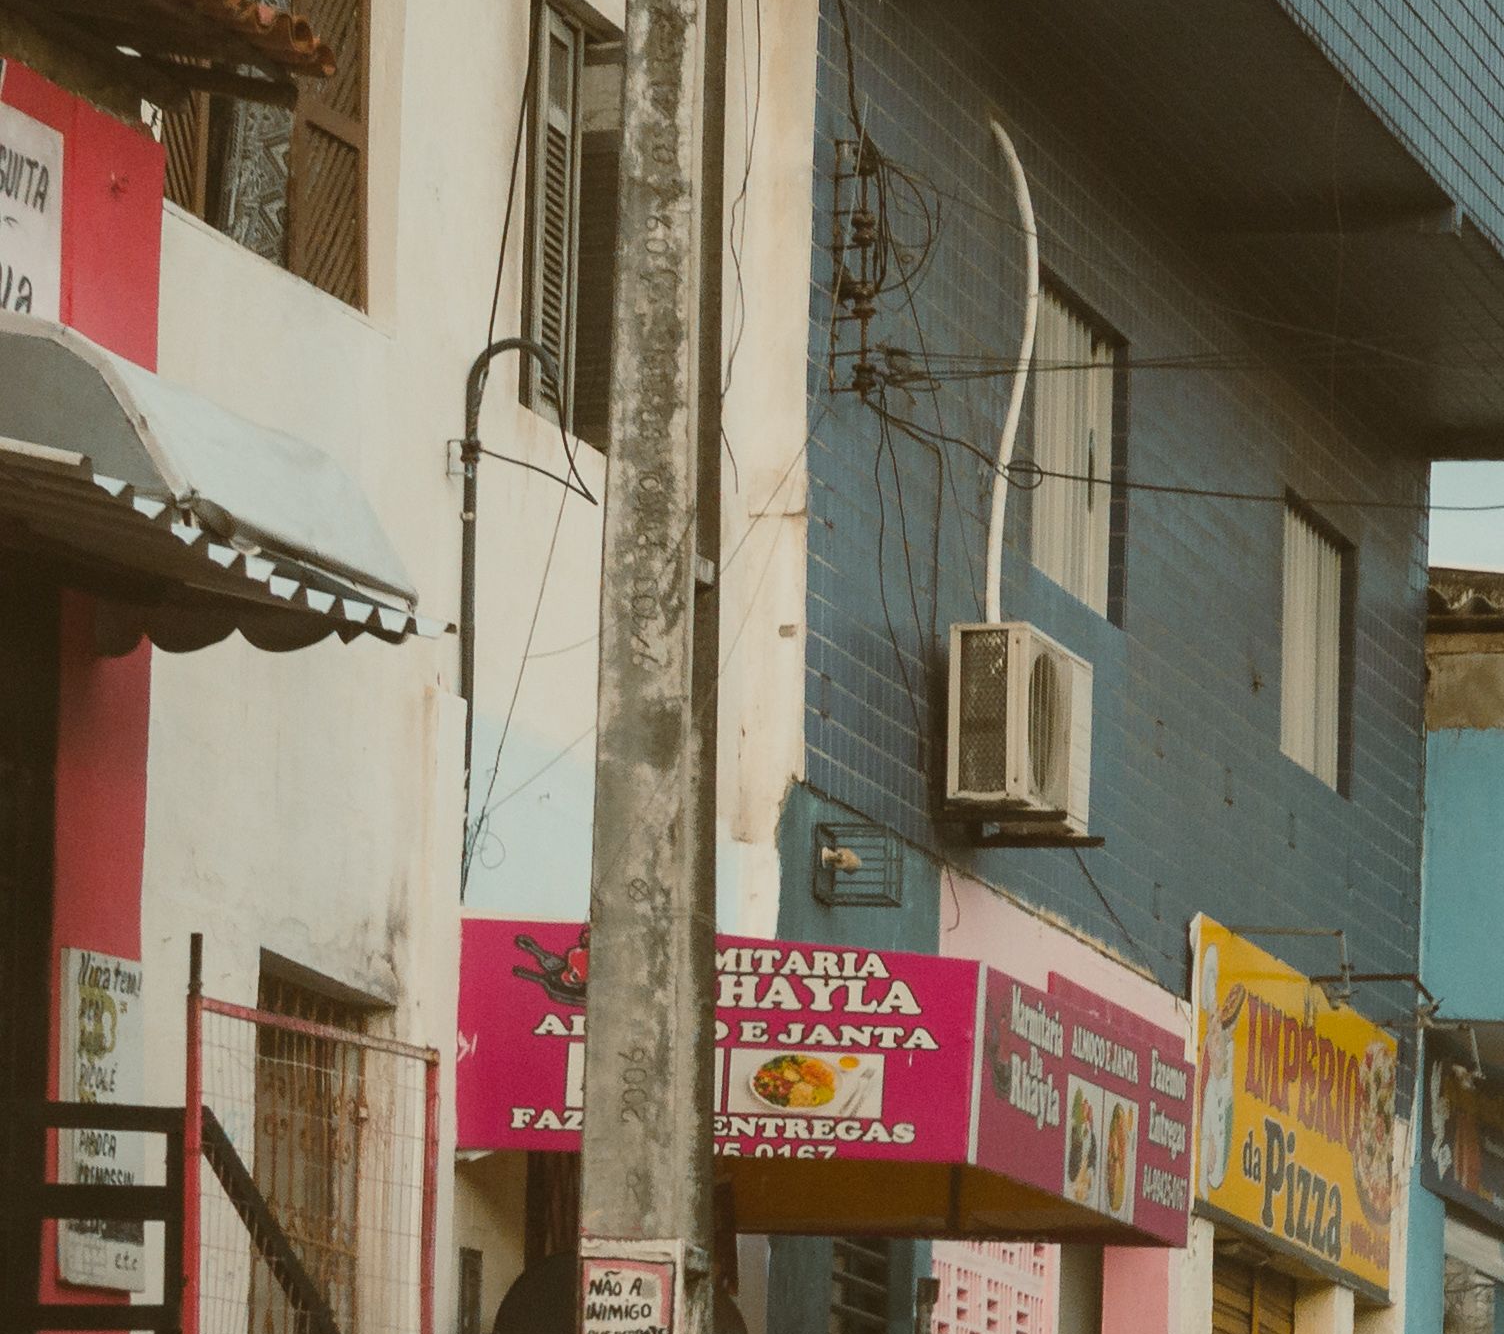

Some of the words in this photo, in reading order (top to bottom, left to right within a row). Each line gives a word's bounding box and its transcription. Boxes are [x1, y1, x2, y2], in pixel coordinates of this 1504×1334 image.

[714, 947, 891, 980] MITARIA
[716, 974, 922, 1015] HAYLA
[739, 1021, 769, 1043] E
[777, 1023, 939, 1050] JANTA
[1242, 1130, 1262, 1184] da
[1260, 1116, 1343, 1263] Pizza
[588, 1270, 622, 1297] NÃO
[587, 1298, 652, 1321] INIMIGO
